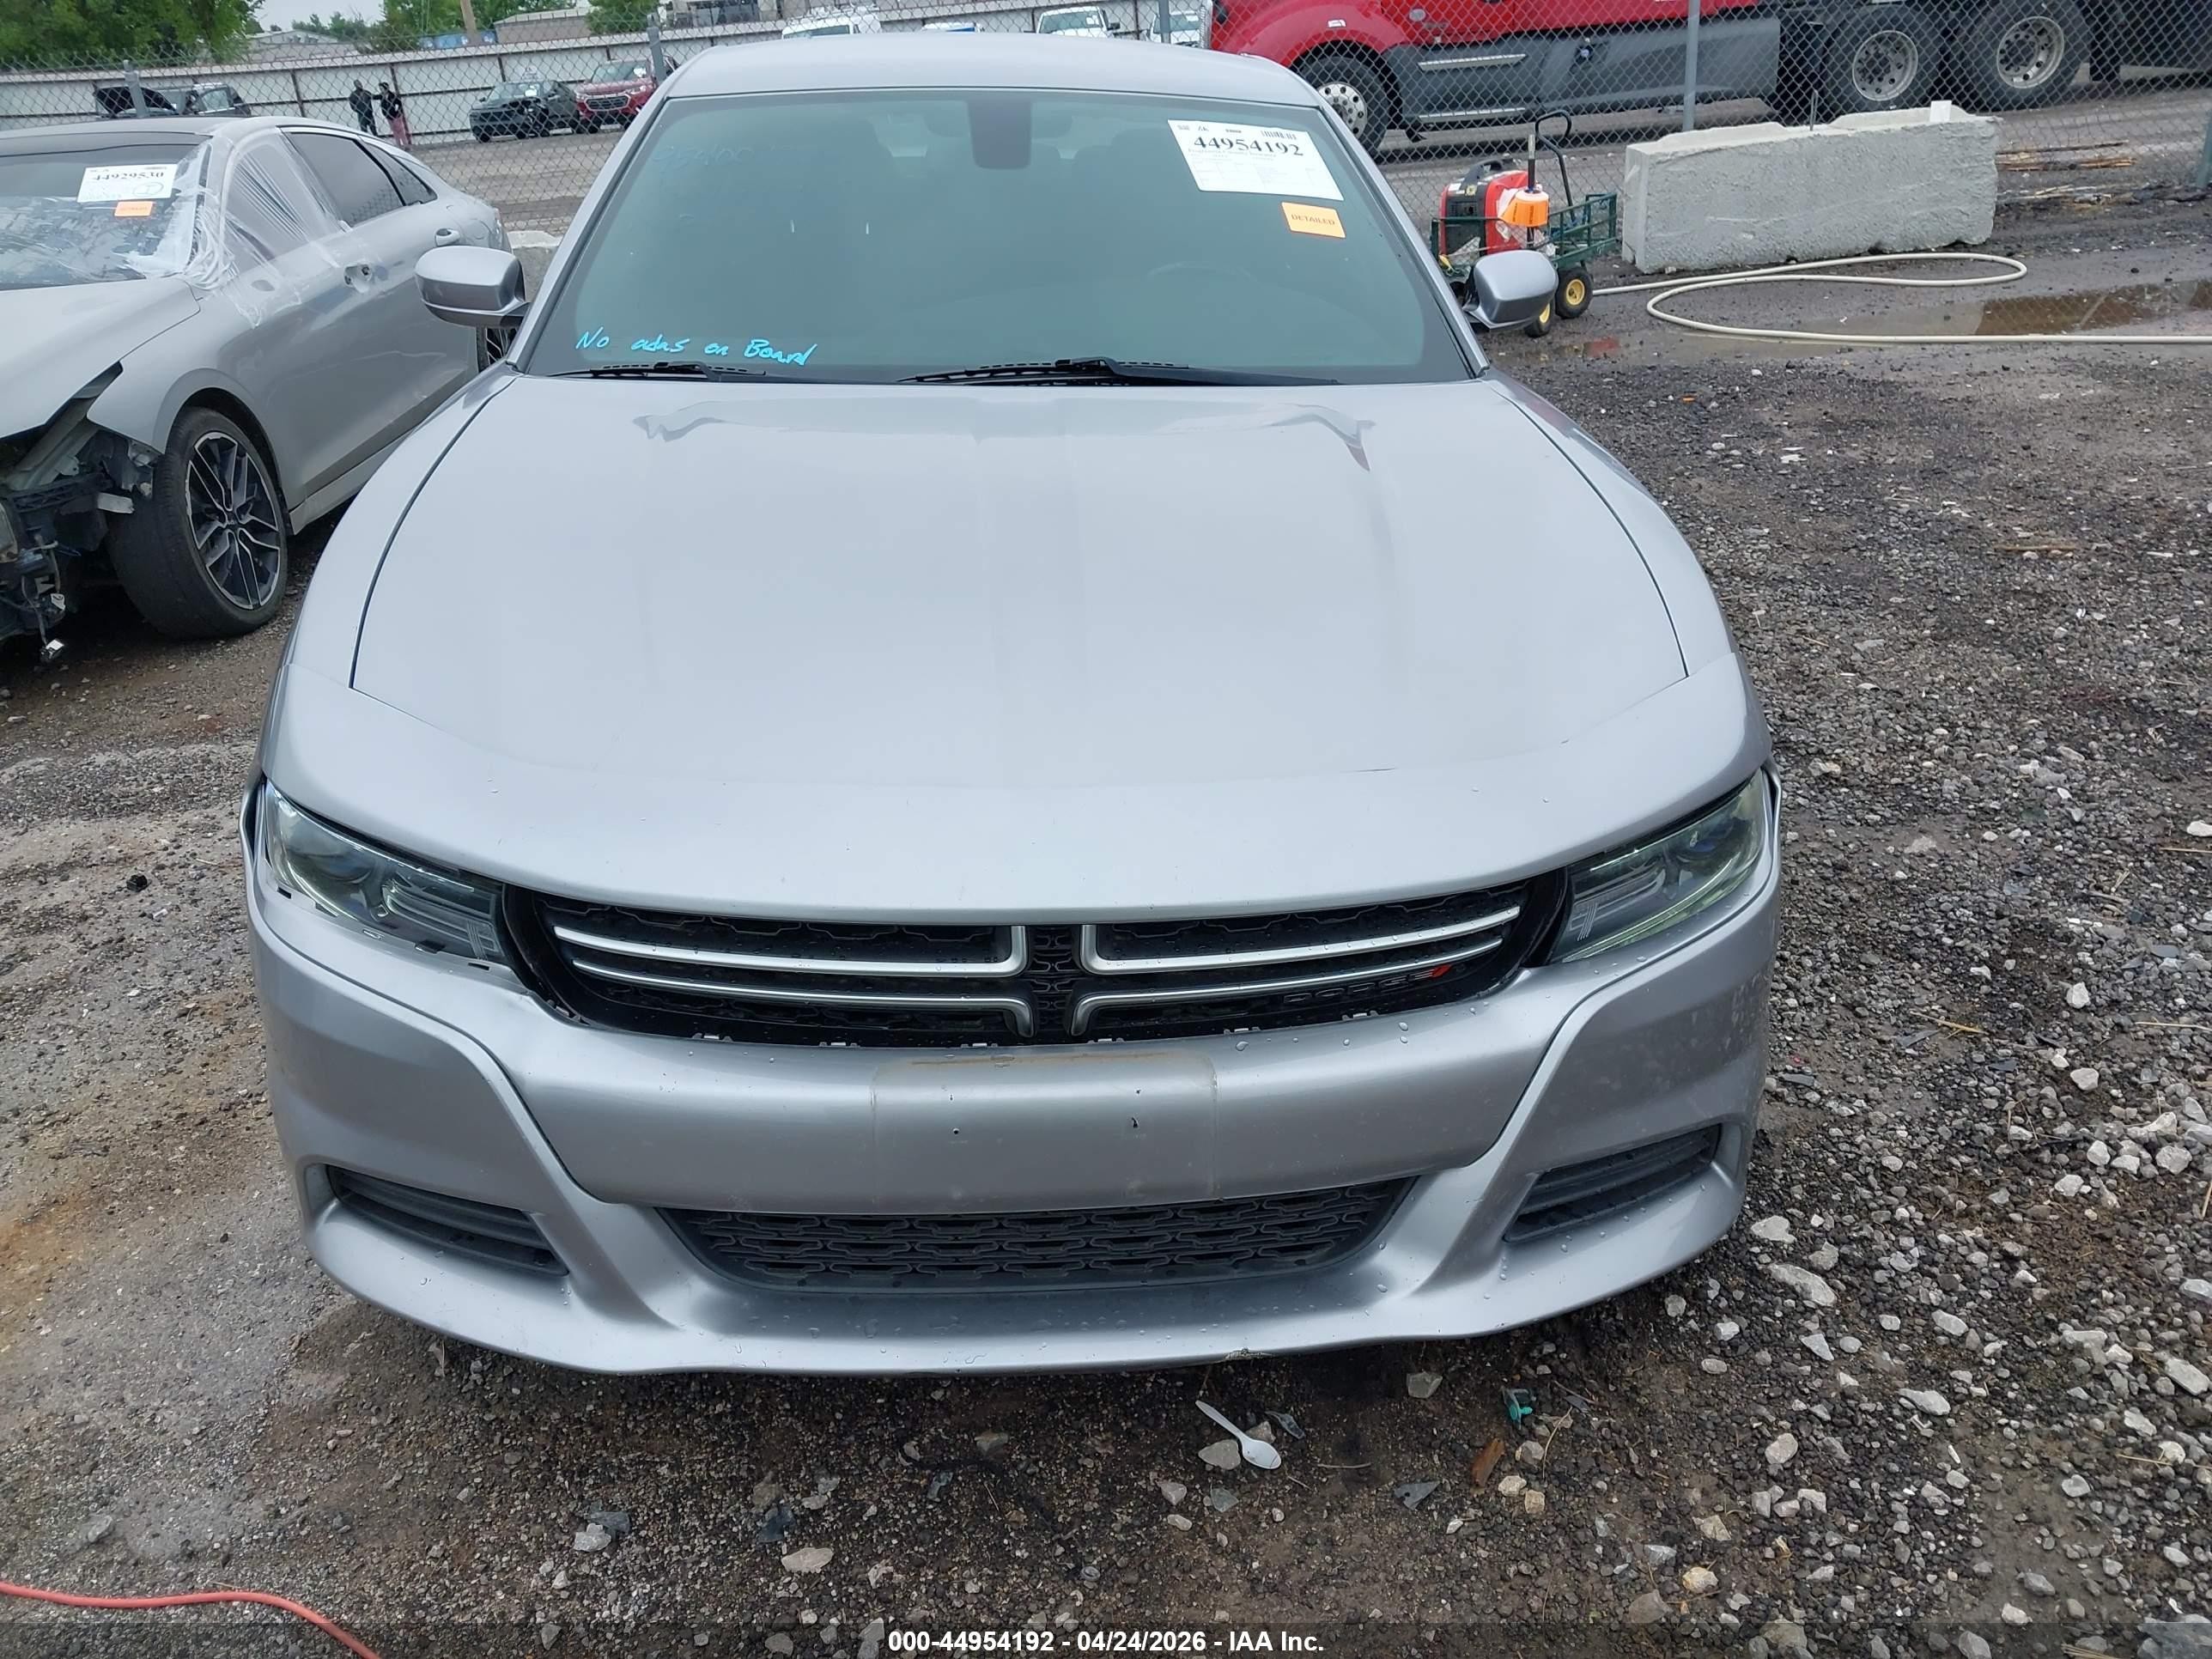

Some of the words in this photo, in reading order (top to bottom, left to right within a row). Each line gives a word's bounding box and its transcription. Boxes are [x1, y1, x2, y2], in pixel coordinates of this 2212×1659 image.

[1194, 136, 1304, 156] 44954192
[1291, 213, 1336, 226] DETAILED
[574, 327, 610, 349] No
[703, 341, 729, 356] on
[743, 338, 817, 366] Board
